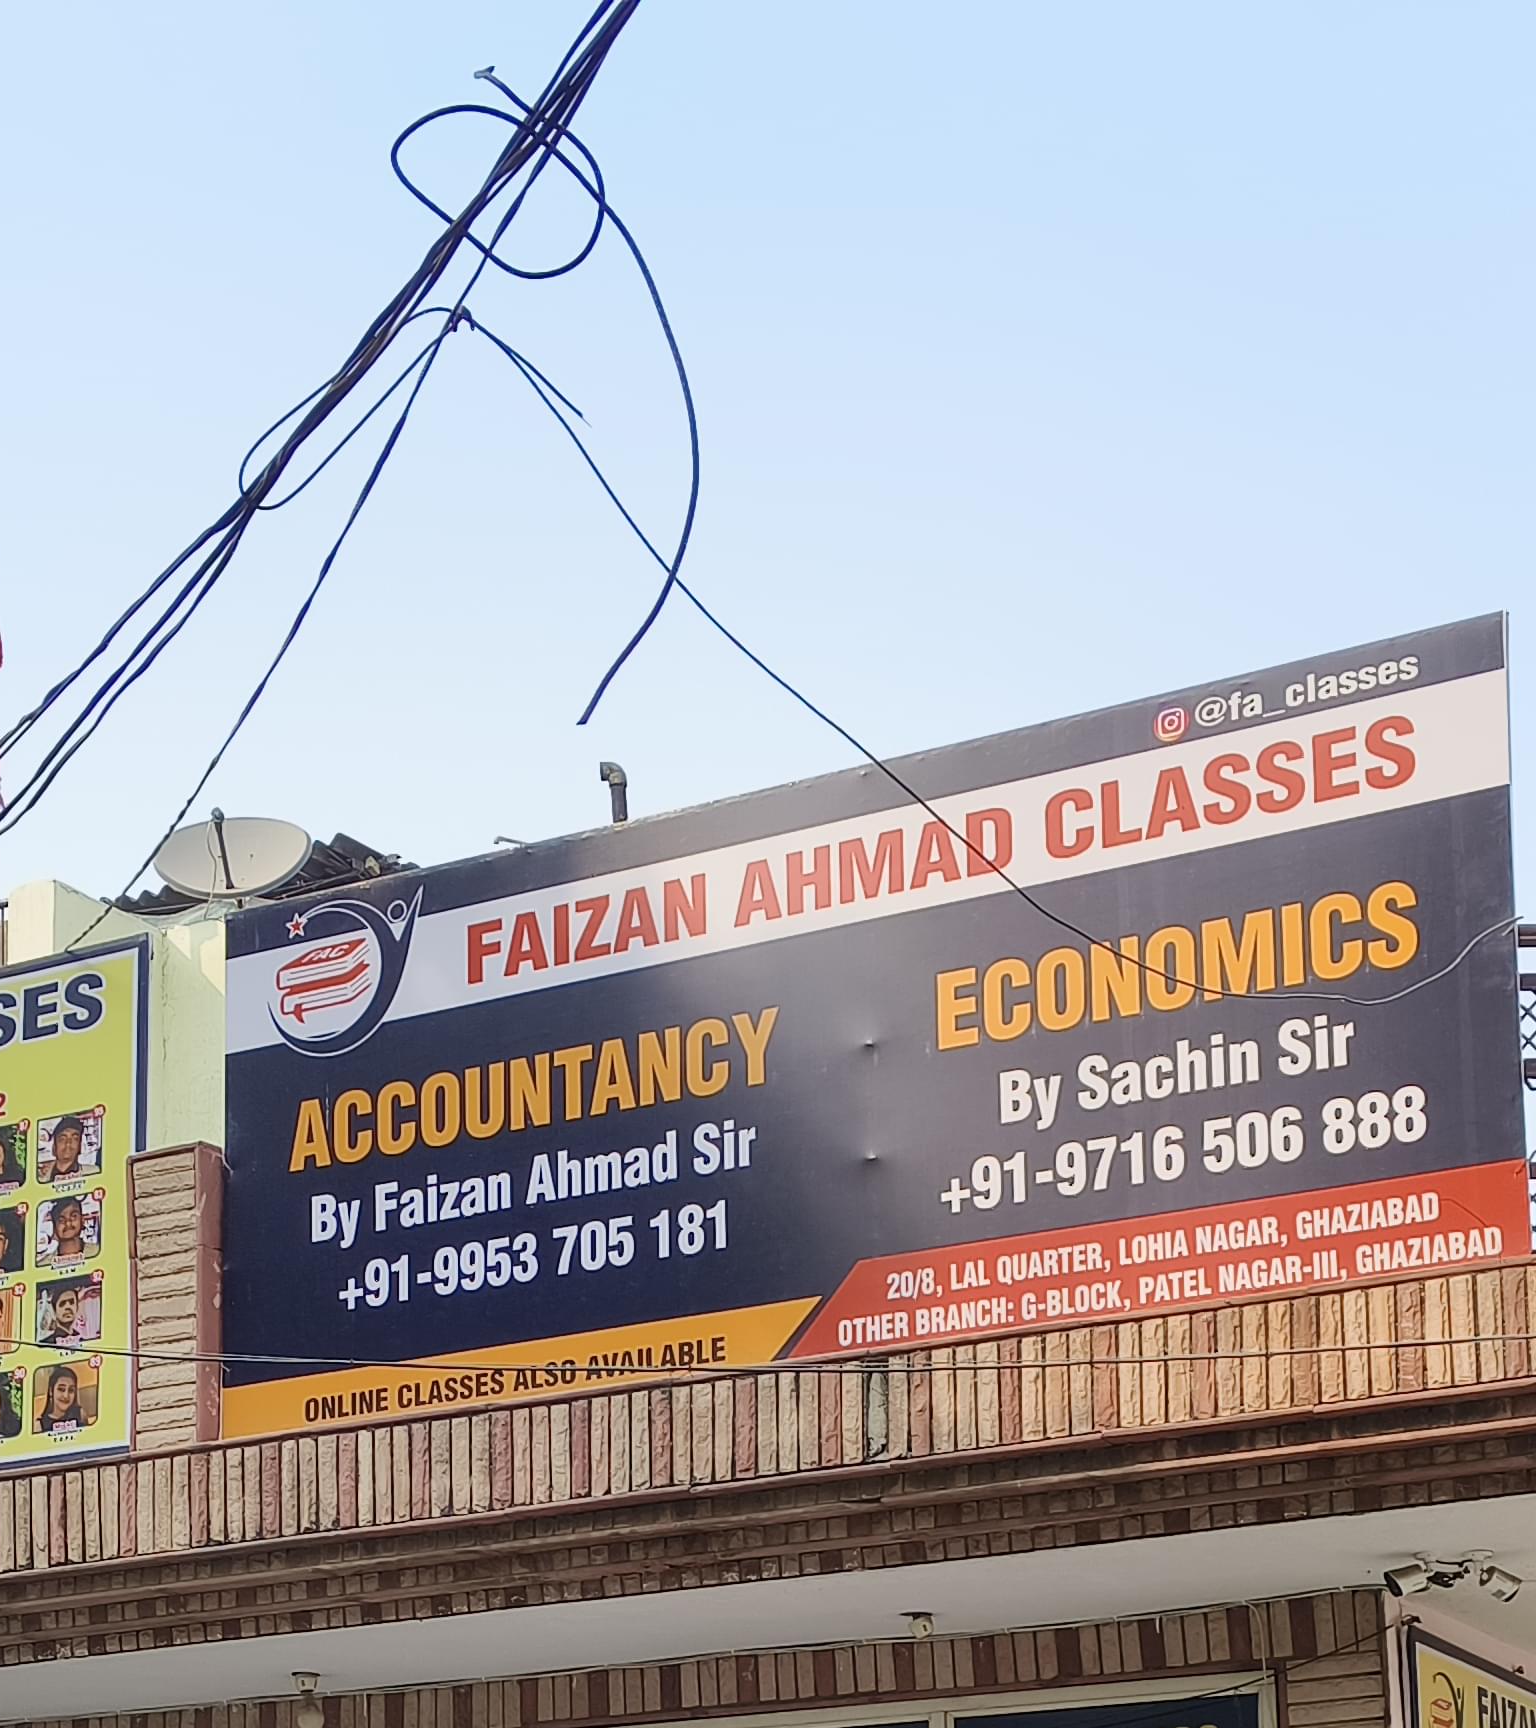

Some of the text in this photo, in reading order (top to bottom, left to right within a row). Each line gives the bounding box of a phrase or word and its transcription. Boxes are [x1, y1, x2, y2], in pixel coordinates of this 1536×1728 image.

[1195, 654, 1419, 727] @fa_classes
[468, 715, 1416, 984] FAIZAN AHMAD CLASSES
[305, 943, 350, 963] FAC
[936, 881, 1418, 1050] ECONOMICS
[289, 1006, 780, 1172] ACCOUNTANCY
[998, 1013, 1355, 1131] By Sachin Sir
[311, 1120, 758, 1249] By Faizan Ahmad Sir
[940, 1085, 1428, 1214] +91-9716 506 888
[339, 1200, 729, 1311] +91-9953 705 181
[837, 1226, 1503, 1347] OTHER BRANCH: G-BLOCK, PATEL NAGAR-III, GHAZIABAD
[886, 1191, 1440, 1301] 20/8, LAL QUARTER, LOHIA NAGAR, GHAZIABAD
[305, 1336, 727, 1423] ONLINE CLASSES ALSO AVAILABLE
